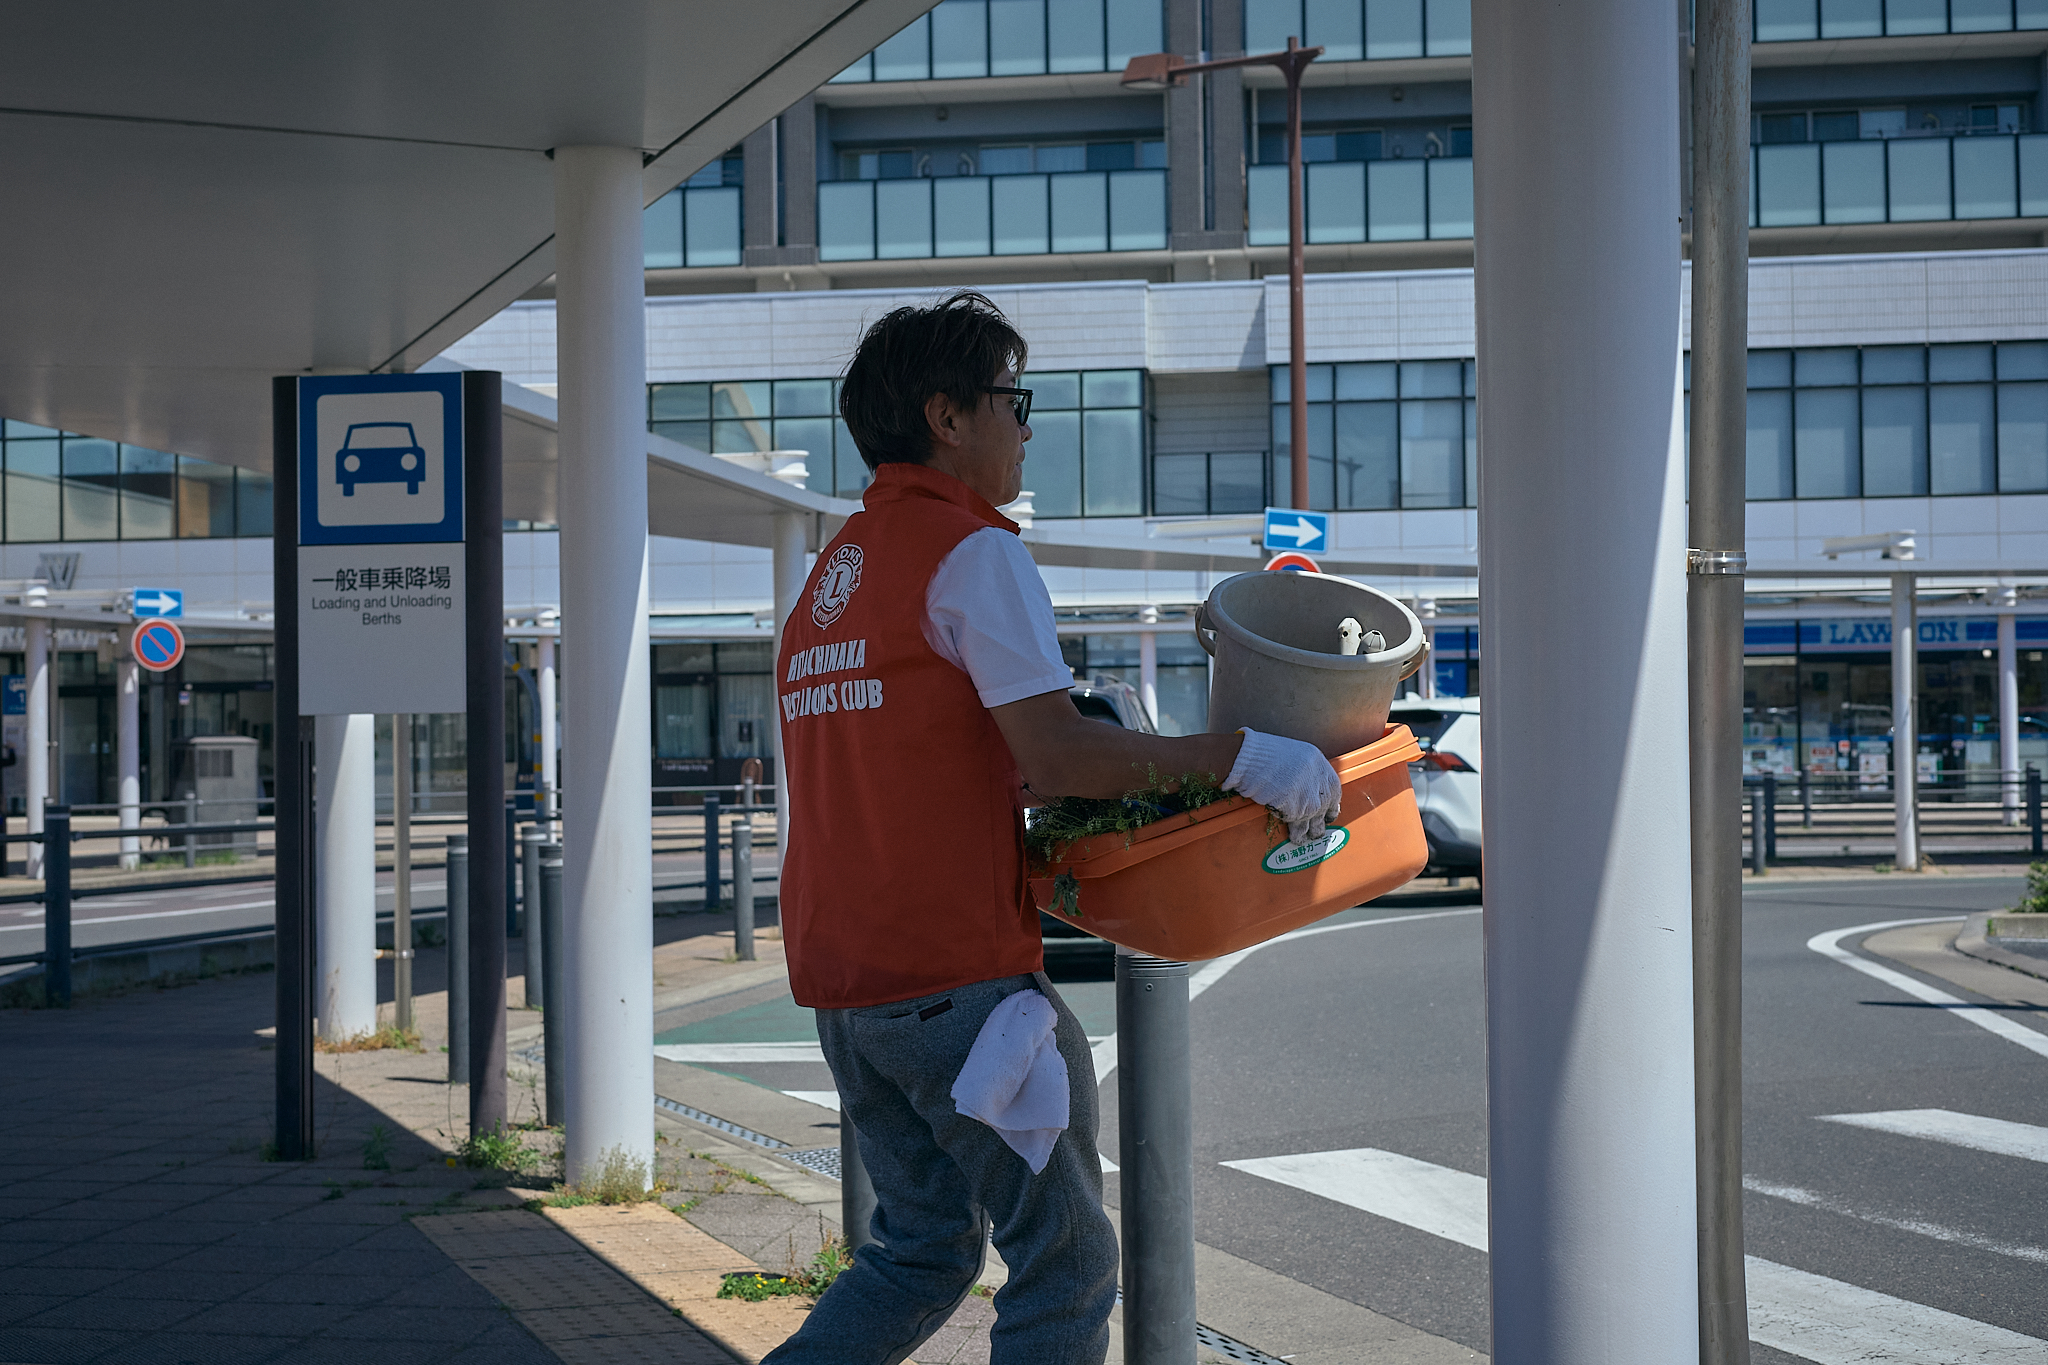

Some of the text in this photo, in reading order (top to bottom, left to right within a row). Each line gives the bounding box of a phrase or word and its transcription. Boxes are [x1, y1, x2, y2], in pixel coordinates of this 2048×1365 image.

[830, 547, 861, 567] LIONS
[312, 566, 451, 592] 一般車乗降場
[828, 570, 844, 600] L
[312, 594, 452, 611] Loading and Unloading
[362, 612, 402, 625] Berths
[1829, 622, 1958, 644] LAWON
[841, 679, 883, 711] CLUB
